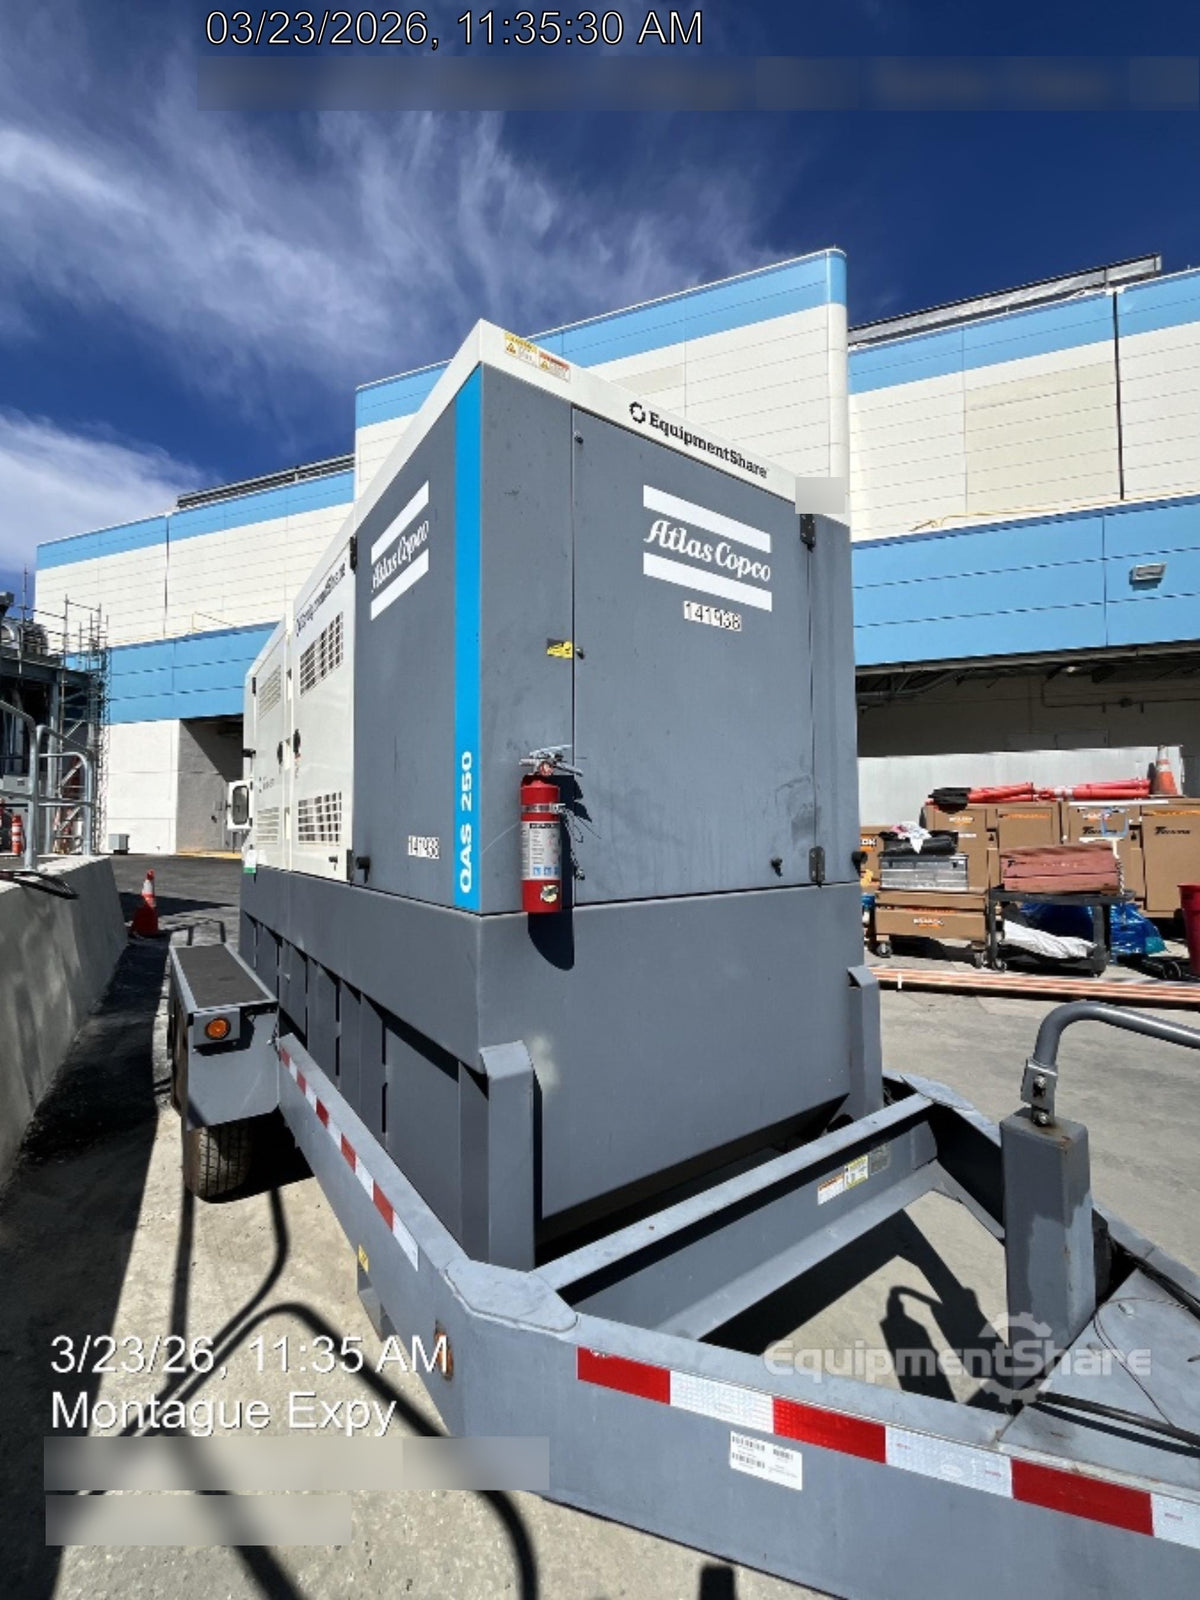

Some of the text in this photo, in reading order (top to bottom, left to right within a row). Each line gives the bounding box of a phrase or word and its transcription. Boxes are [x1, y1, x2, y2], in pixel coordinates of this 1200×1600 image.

[649, 410, 767, 478] EquipmentShare
[371, 520, 430, 593] Atlas Copco
[643, 519, 772, 582] Atlas Copco
[460, 751, 473, 894] QAS 250
